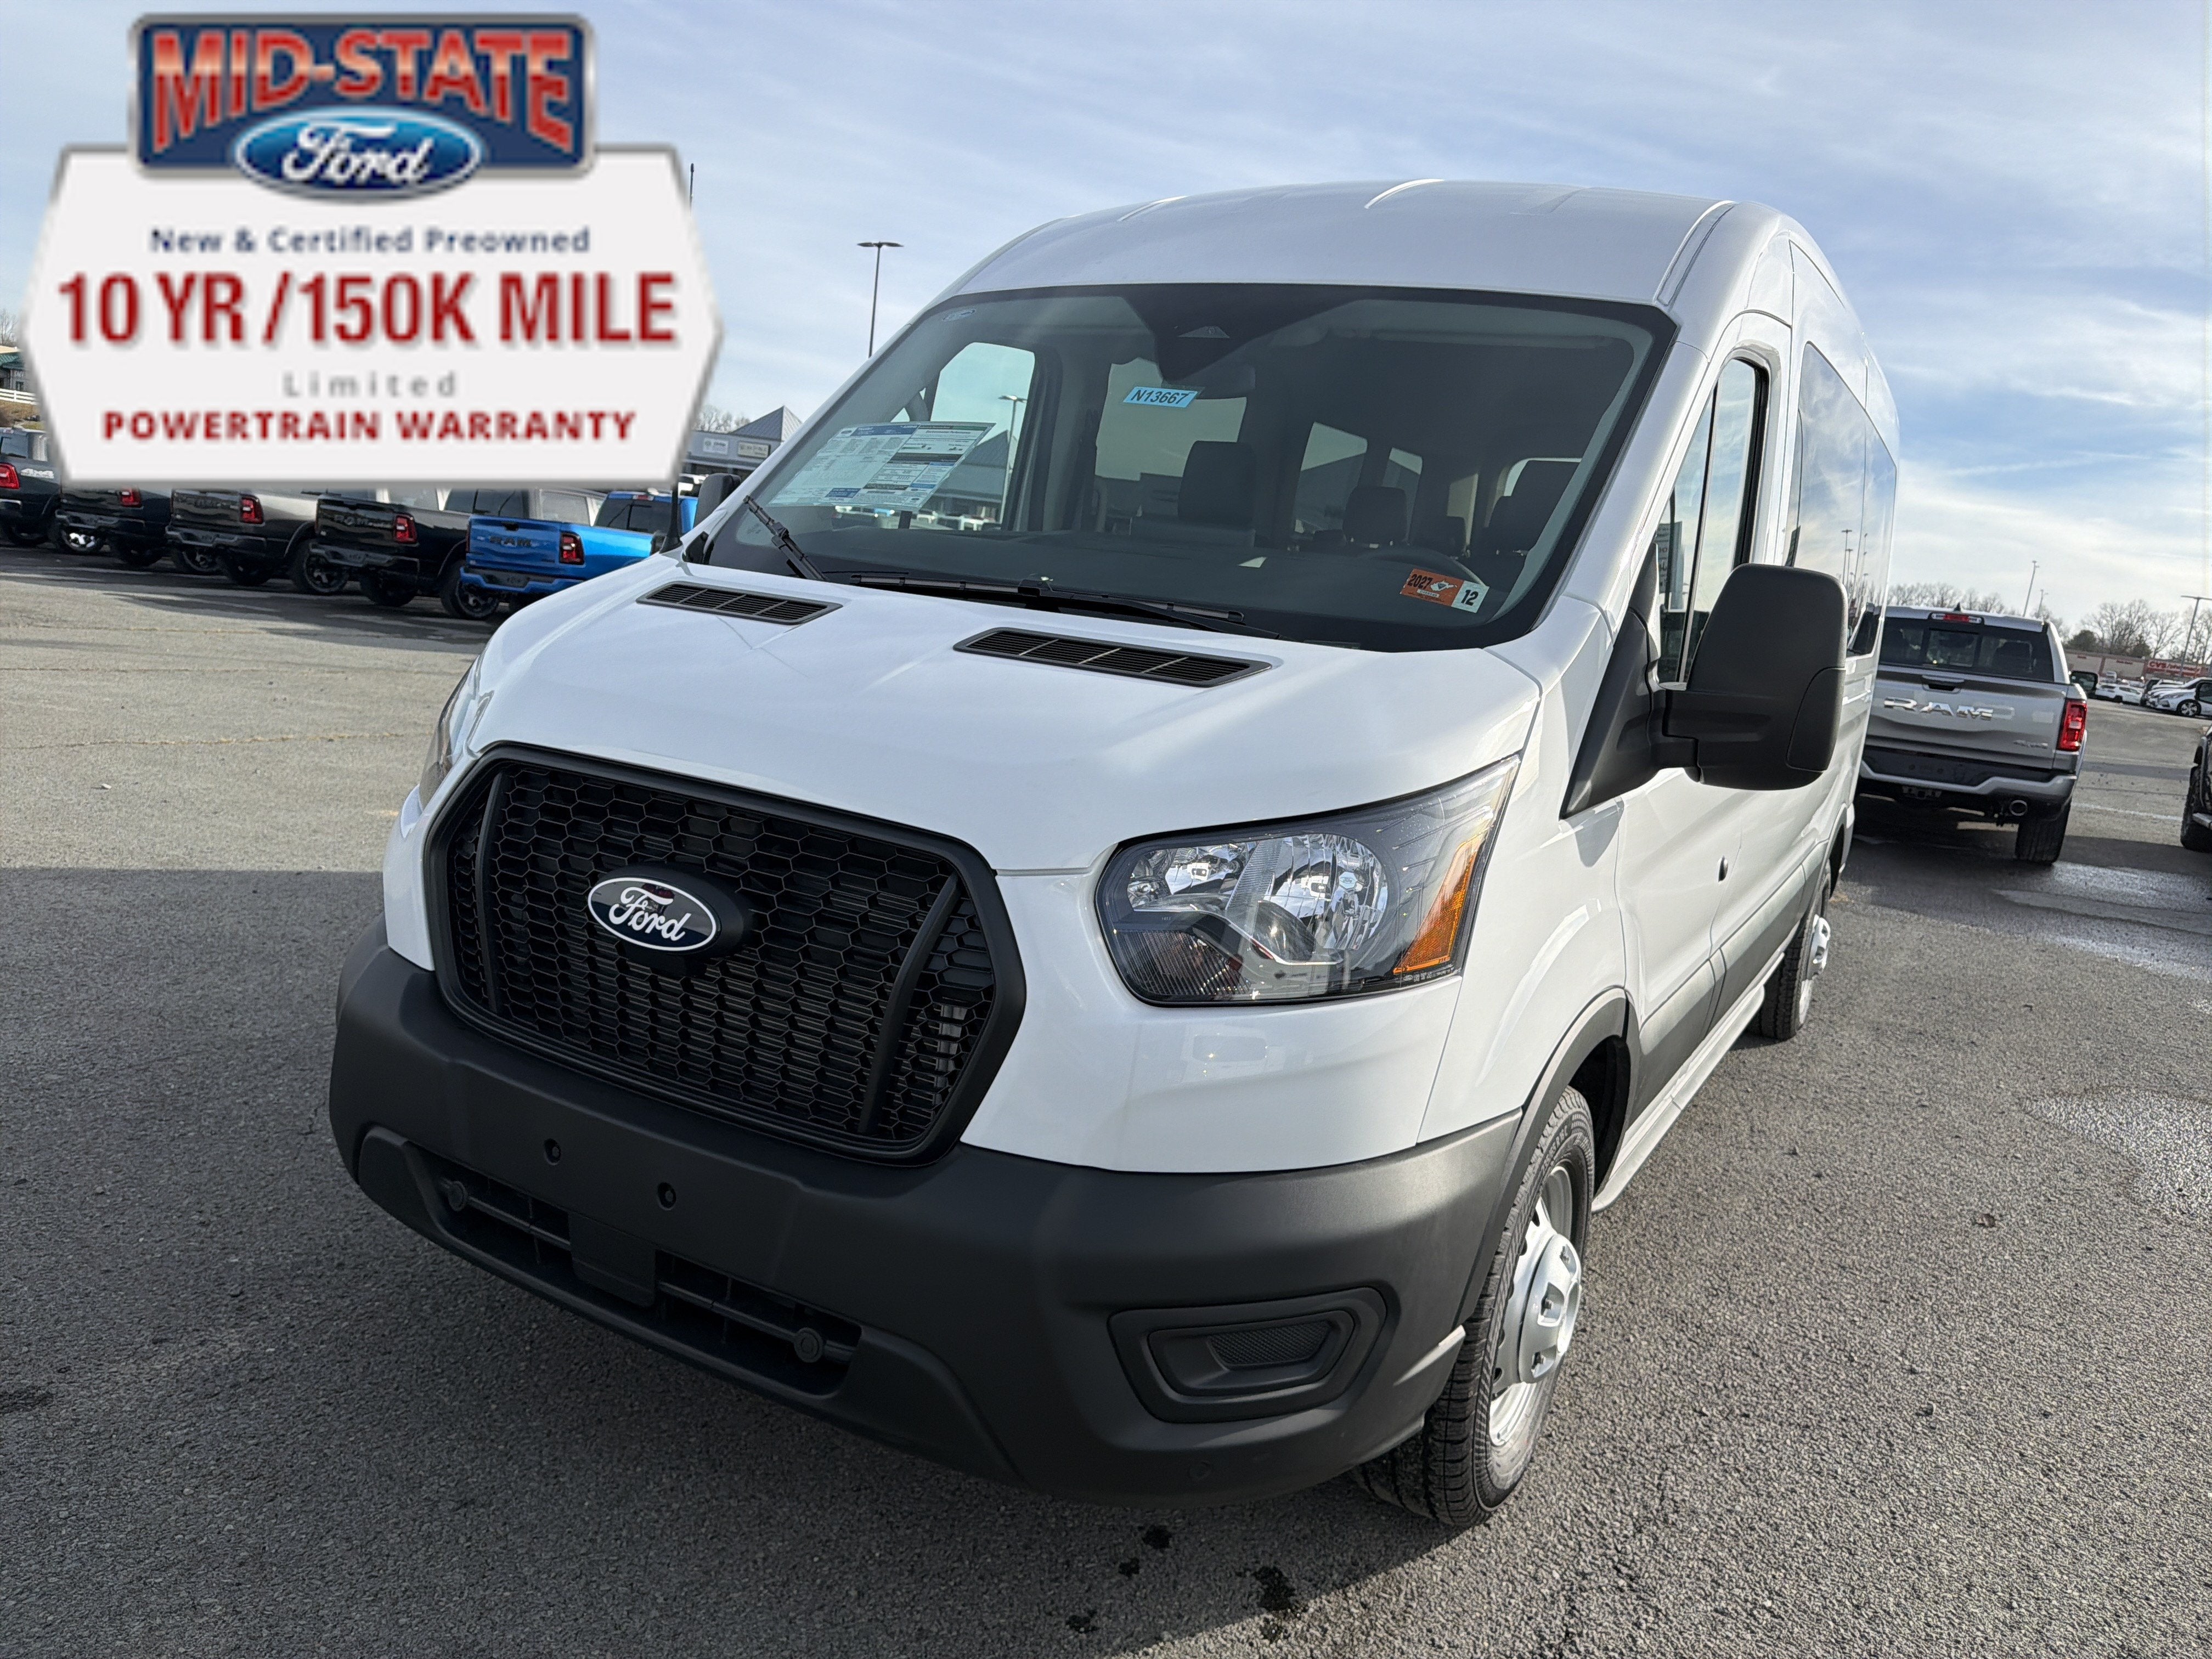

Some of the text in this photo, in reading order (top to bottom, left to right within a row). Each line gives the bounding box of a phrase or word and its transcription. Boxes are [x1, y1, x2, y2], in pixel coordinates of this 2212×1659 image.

[1131, 390, 1189, 404] N13667
[489, 535, 532, 548] RAM
[1408, 573, 1434, 589] 2027
[1460, 589, 1479, 606] 12
[1884, 697, 1994, 721] RAM
[608, 887, 692, 942] Ford
